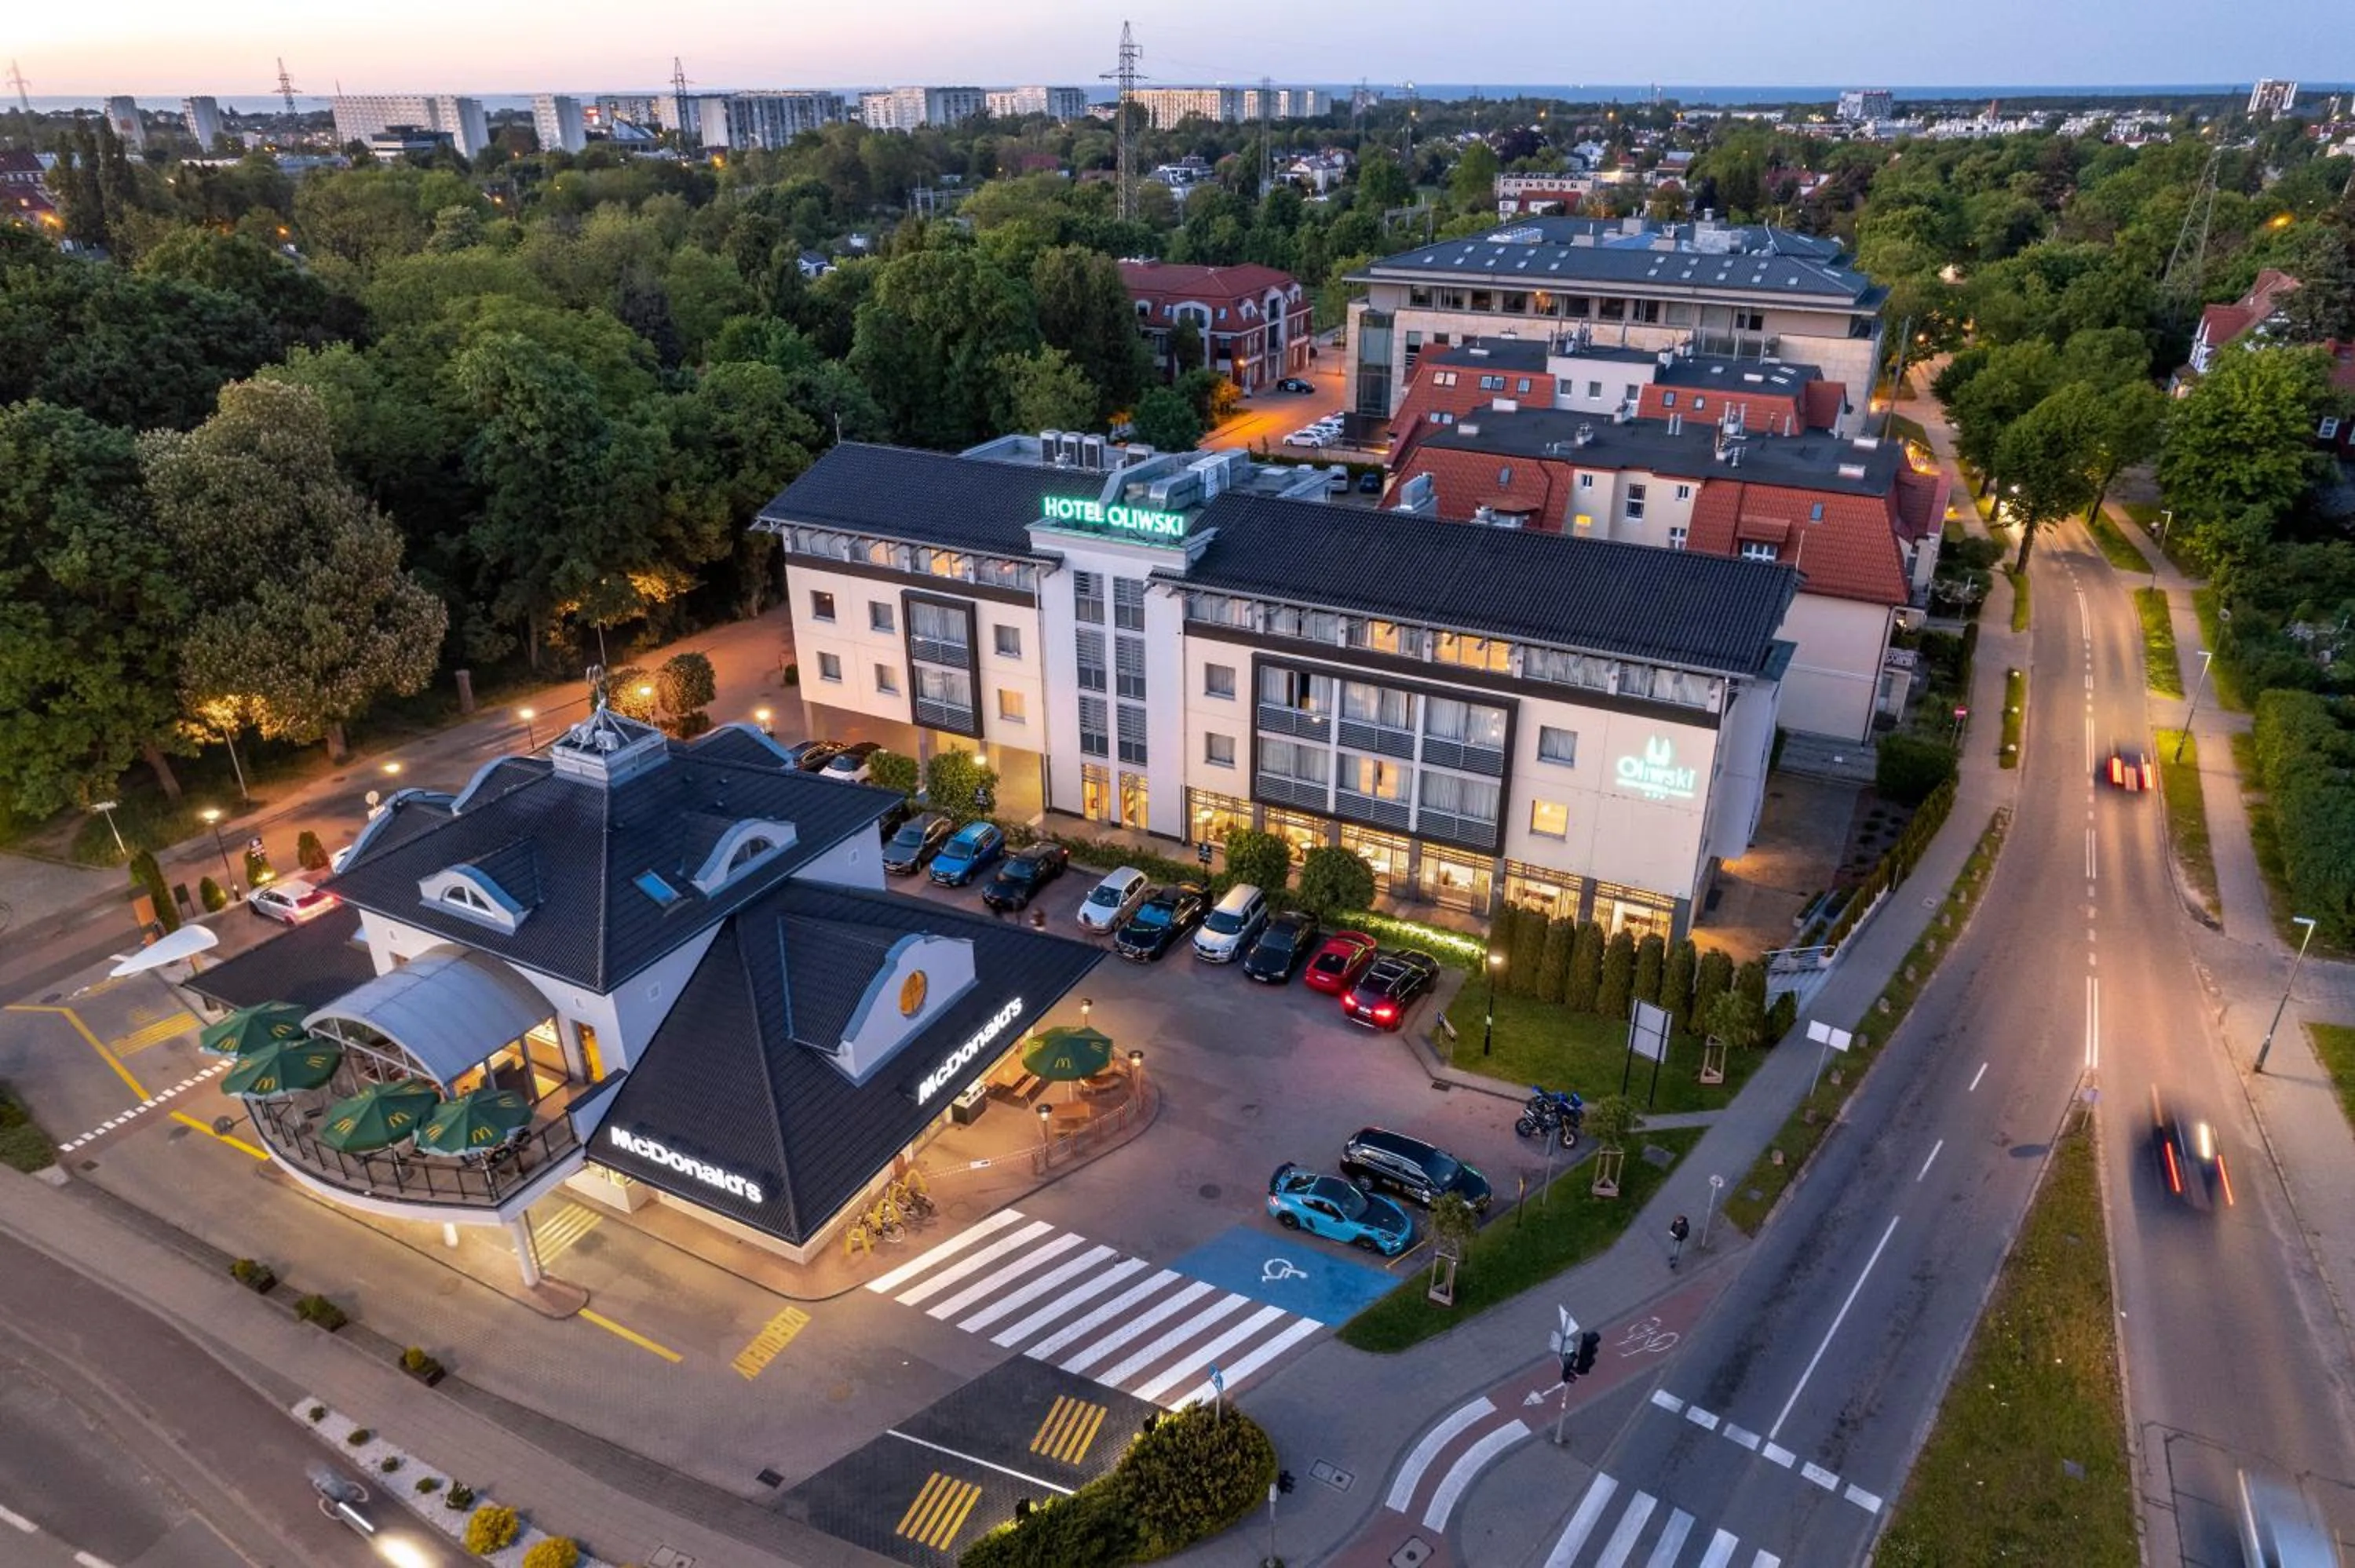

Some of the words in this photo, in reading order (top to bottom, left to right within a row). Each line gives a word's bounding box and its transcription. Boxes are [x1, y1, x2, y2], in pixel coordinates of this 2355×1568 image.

[1044, 497, 1104, 522] HOTEL
[1108, 506, 1184, 536] OLIWSKI
[918, 997, 1023, 1106] McDonald's
[610, 1126, 763, 1203] McDonald's
